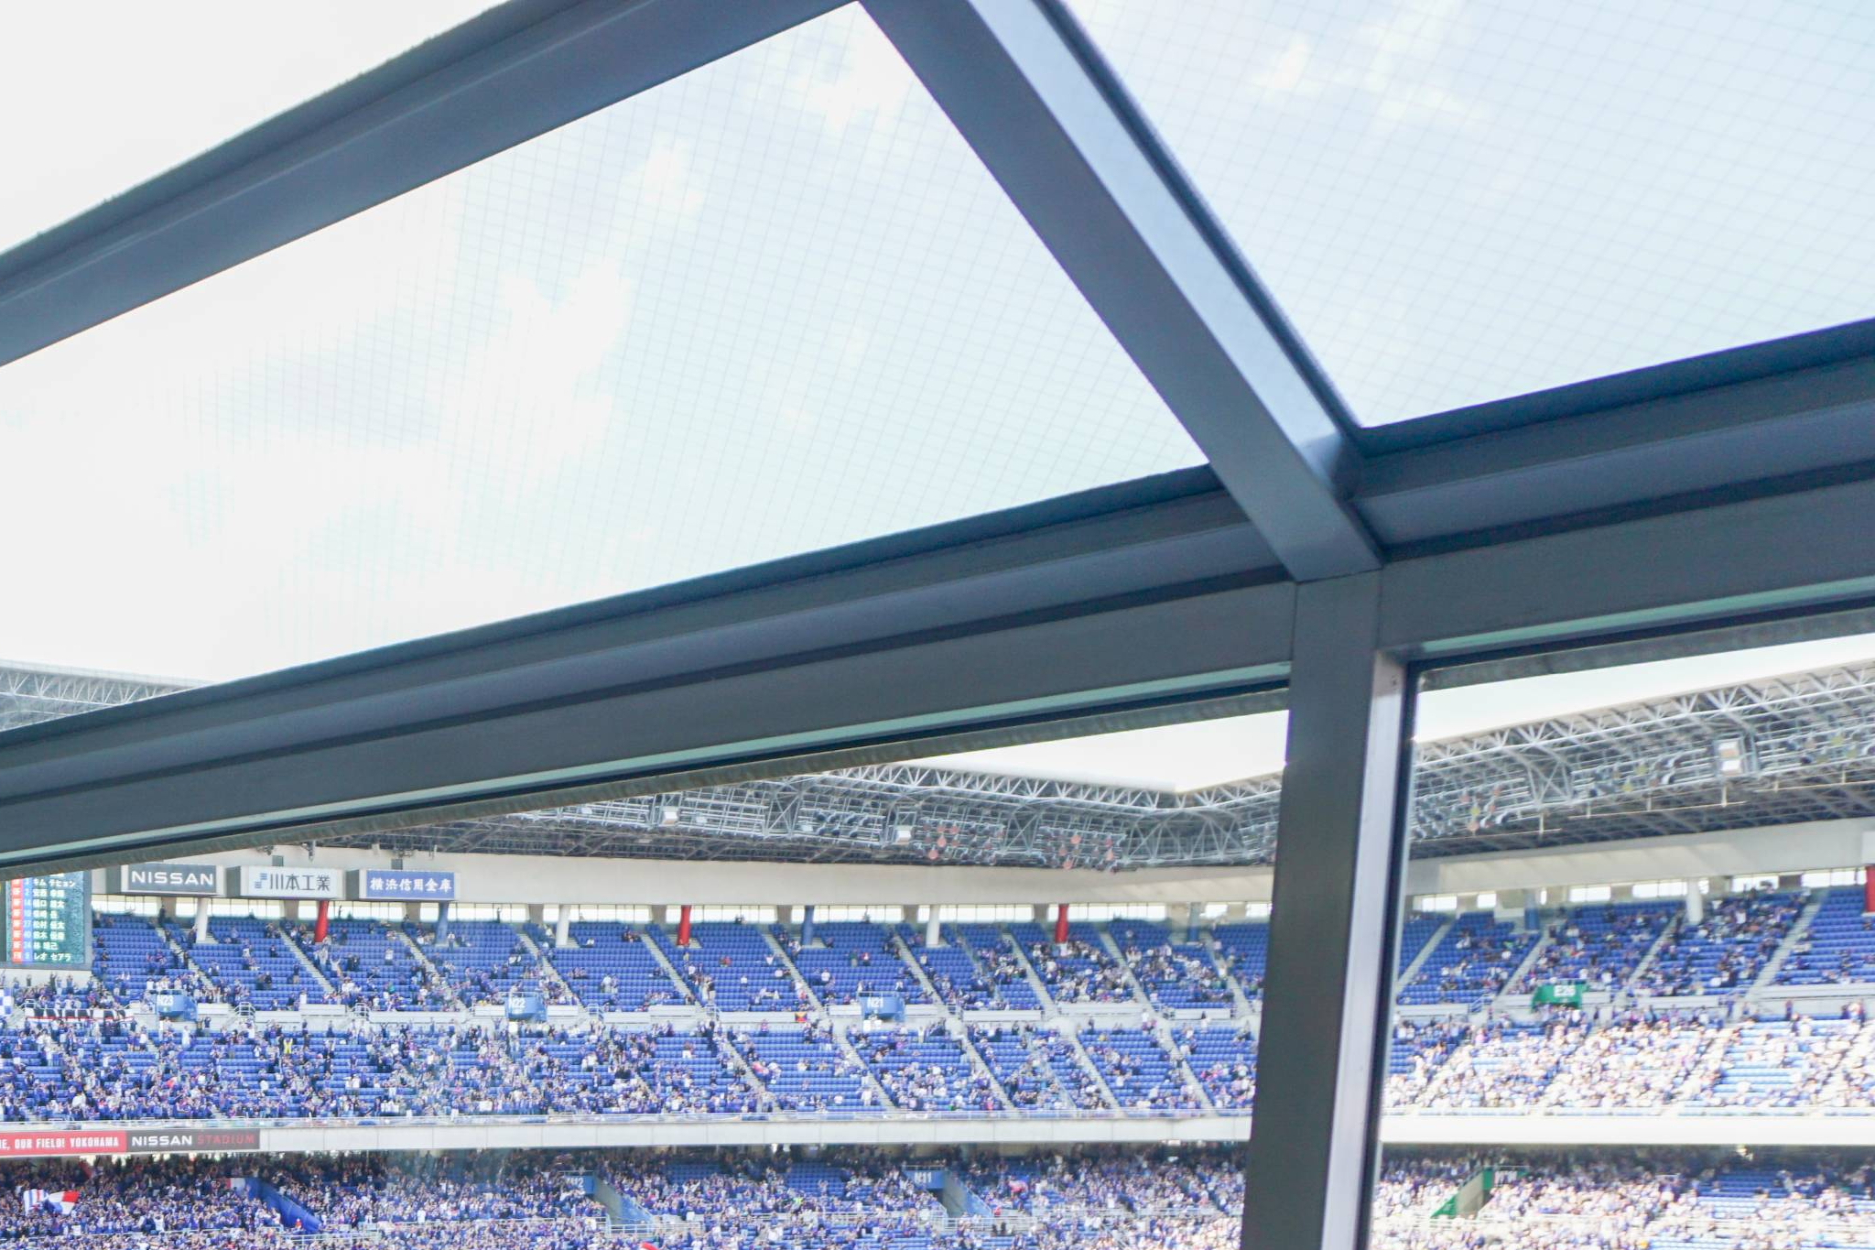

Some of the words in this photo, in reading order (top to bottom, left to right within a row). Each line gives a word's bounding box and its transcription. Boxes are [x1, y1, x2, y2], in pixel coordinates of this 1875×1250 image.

[131, 869, 214, 886] NISSAN
[268, 873, 331, 892] 川本工業
[369, 876, 452, 893] 横浜信用金庫
[14, 1138, 33, 1149] OUR
[70, 1136, 119, 1148] YOKOHAMA
[131, 1135, 193, 1146] NISSAN
[197, 1133, 255, 1145] STADIUM
